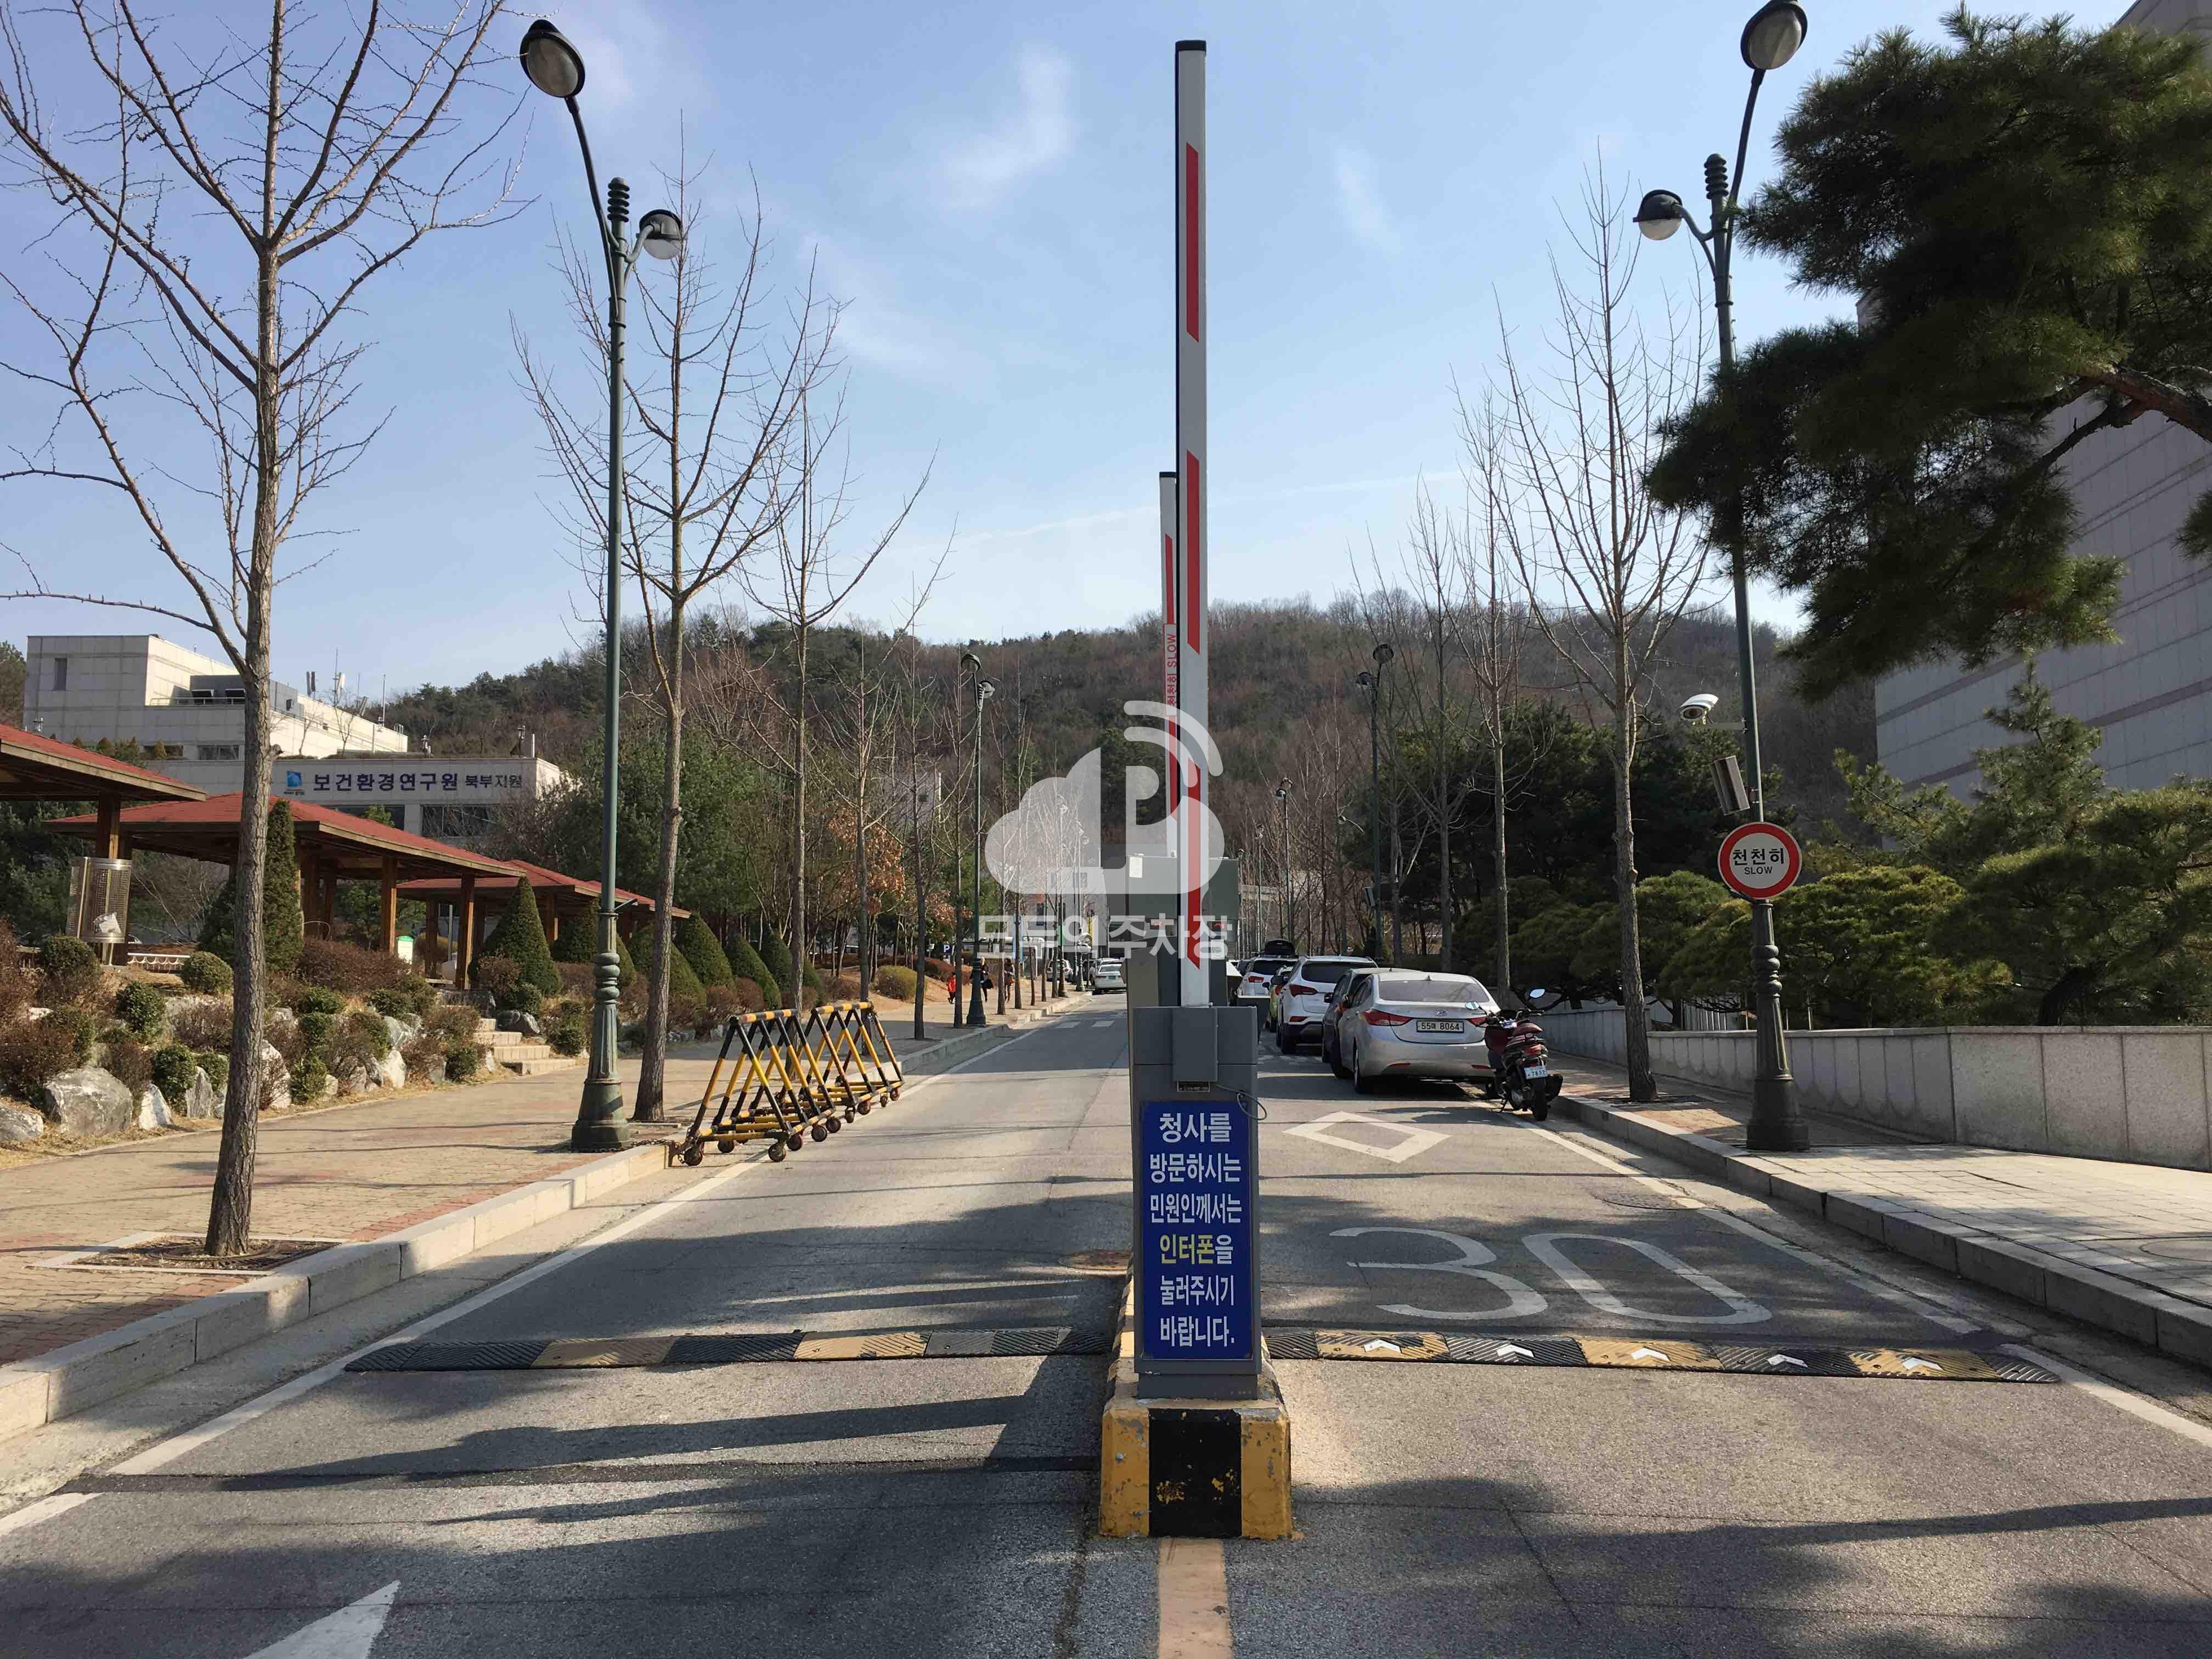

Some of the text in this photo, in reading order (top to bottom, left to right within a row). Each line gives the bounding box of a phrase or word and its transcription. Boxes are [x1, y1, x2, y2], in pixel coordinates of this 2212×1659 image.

[1167, 634, 1177, 668] SLOW
[313, 773, 522, 791] 보건환경연구원 북부지원
[1733, 848, 1785, 866] 천천히
[1744, 866, 1773, 874] SLOW
[944, 944, 950, 953] P
[1440, 1022, 1459, 1030] 8064
[1159, 1113, 1232, 1143] 청사를
[1150, 1153, 1242, 1183] 방문하시는
[1149, 1193, 1242, 1224] 민원인께서는
[1159, 1234, 1233, 1265] 인터폰을
[1160, 1275, 1234, 1306] 눌러주시기
[1329, 1226, 1773, 1325] 30
[1160, 1316, 1235, 1347] 바랍니다.
